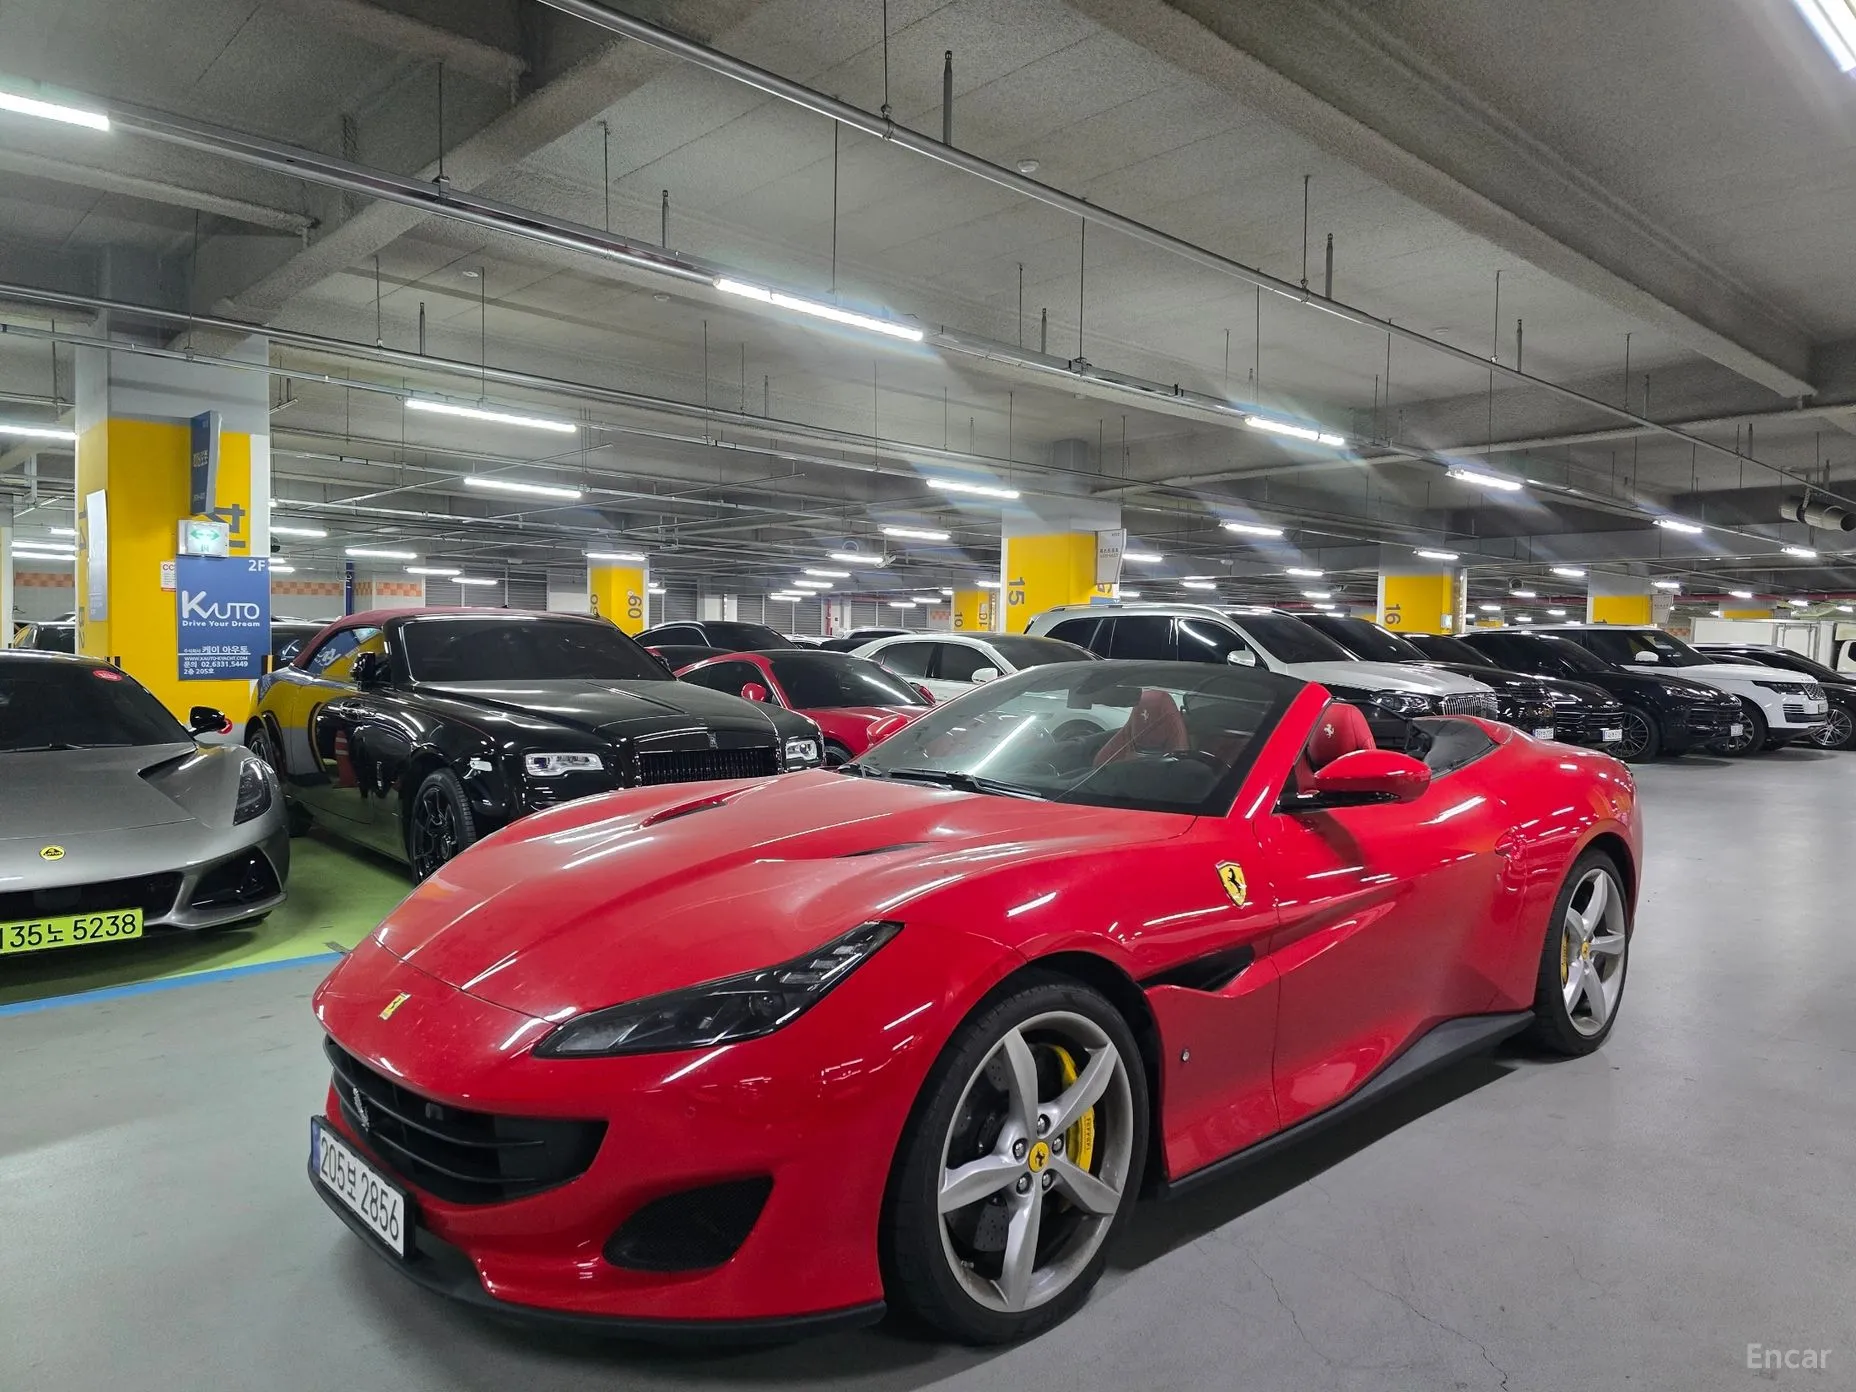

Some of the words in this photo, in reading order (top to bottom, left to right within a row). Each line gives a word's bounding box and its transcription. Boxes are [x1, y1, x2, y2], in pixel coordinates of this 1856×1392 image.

[248, 560, 266, 572] 2F
[1008, 577, 1026, 605] 15
[1385, 604, 1401, 624] 16
[73, 913, 136, 941] 5238
[321, 1136, 356, 1202] 205보
[361, 1171, 399, 1241] 2856
